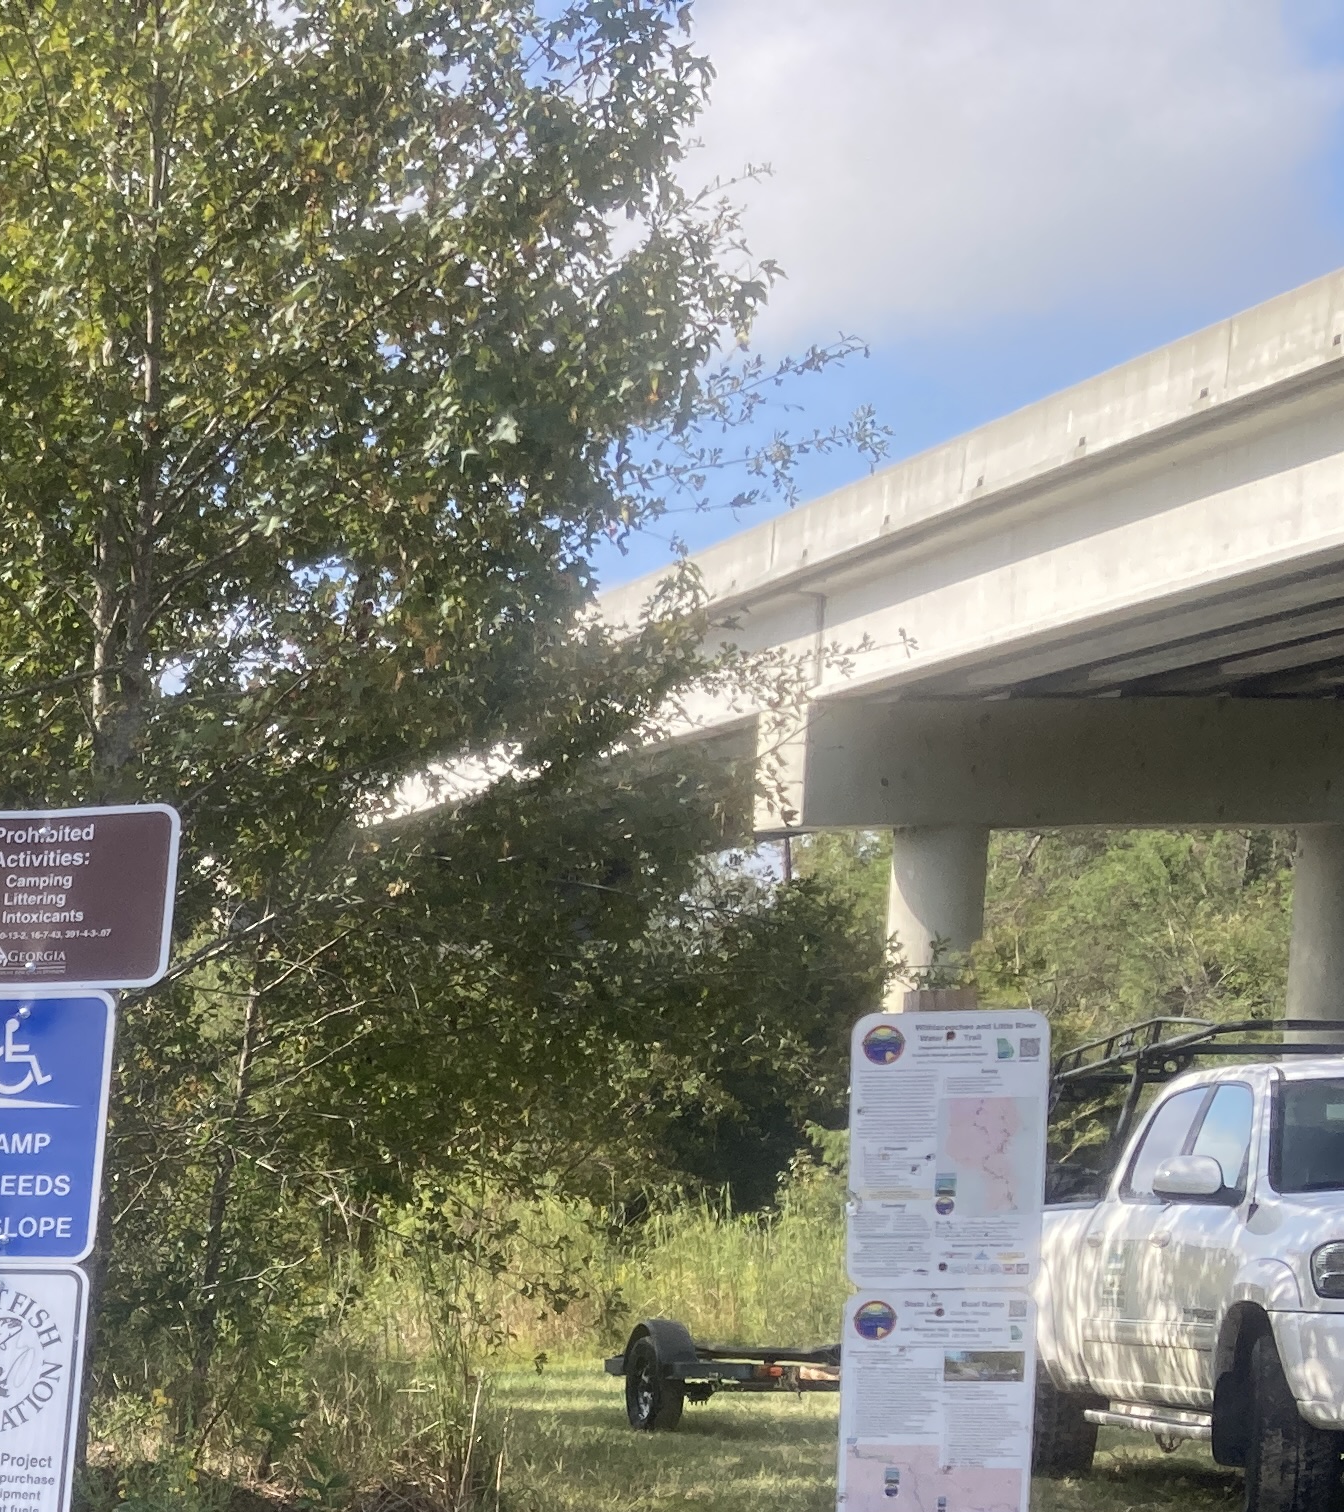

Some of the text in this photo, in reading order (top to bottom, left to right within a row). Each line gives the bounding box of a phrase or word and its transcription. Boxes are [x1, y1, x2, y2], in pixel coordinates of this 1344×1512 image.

[5, 873, 73, 890] Camping
[3, 891, 66, 908] Littering
[1, 909, 84, 924] Intoxicants
[0, 1452, 53, 1471] Project
[0, 1472, 56, 1486] purchase
